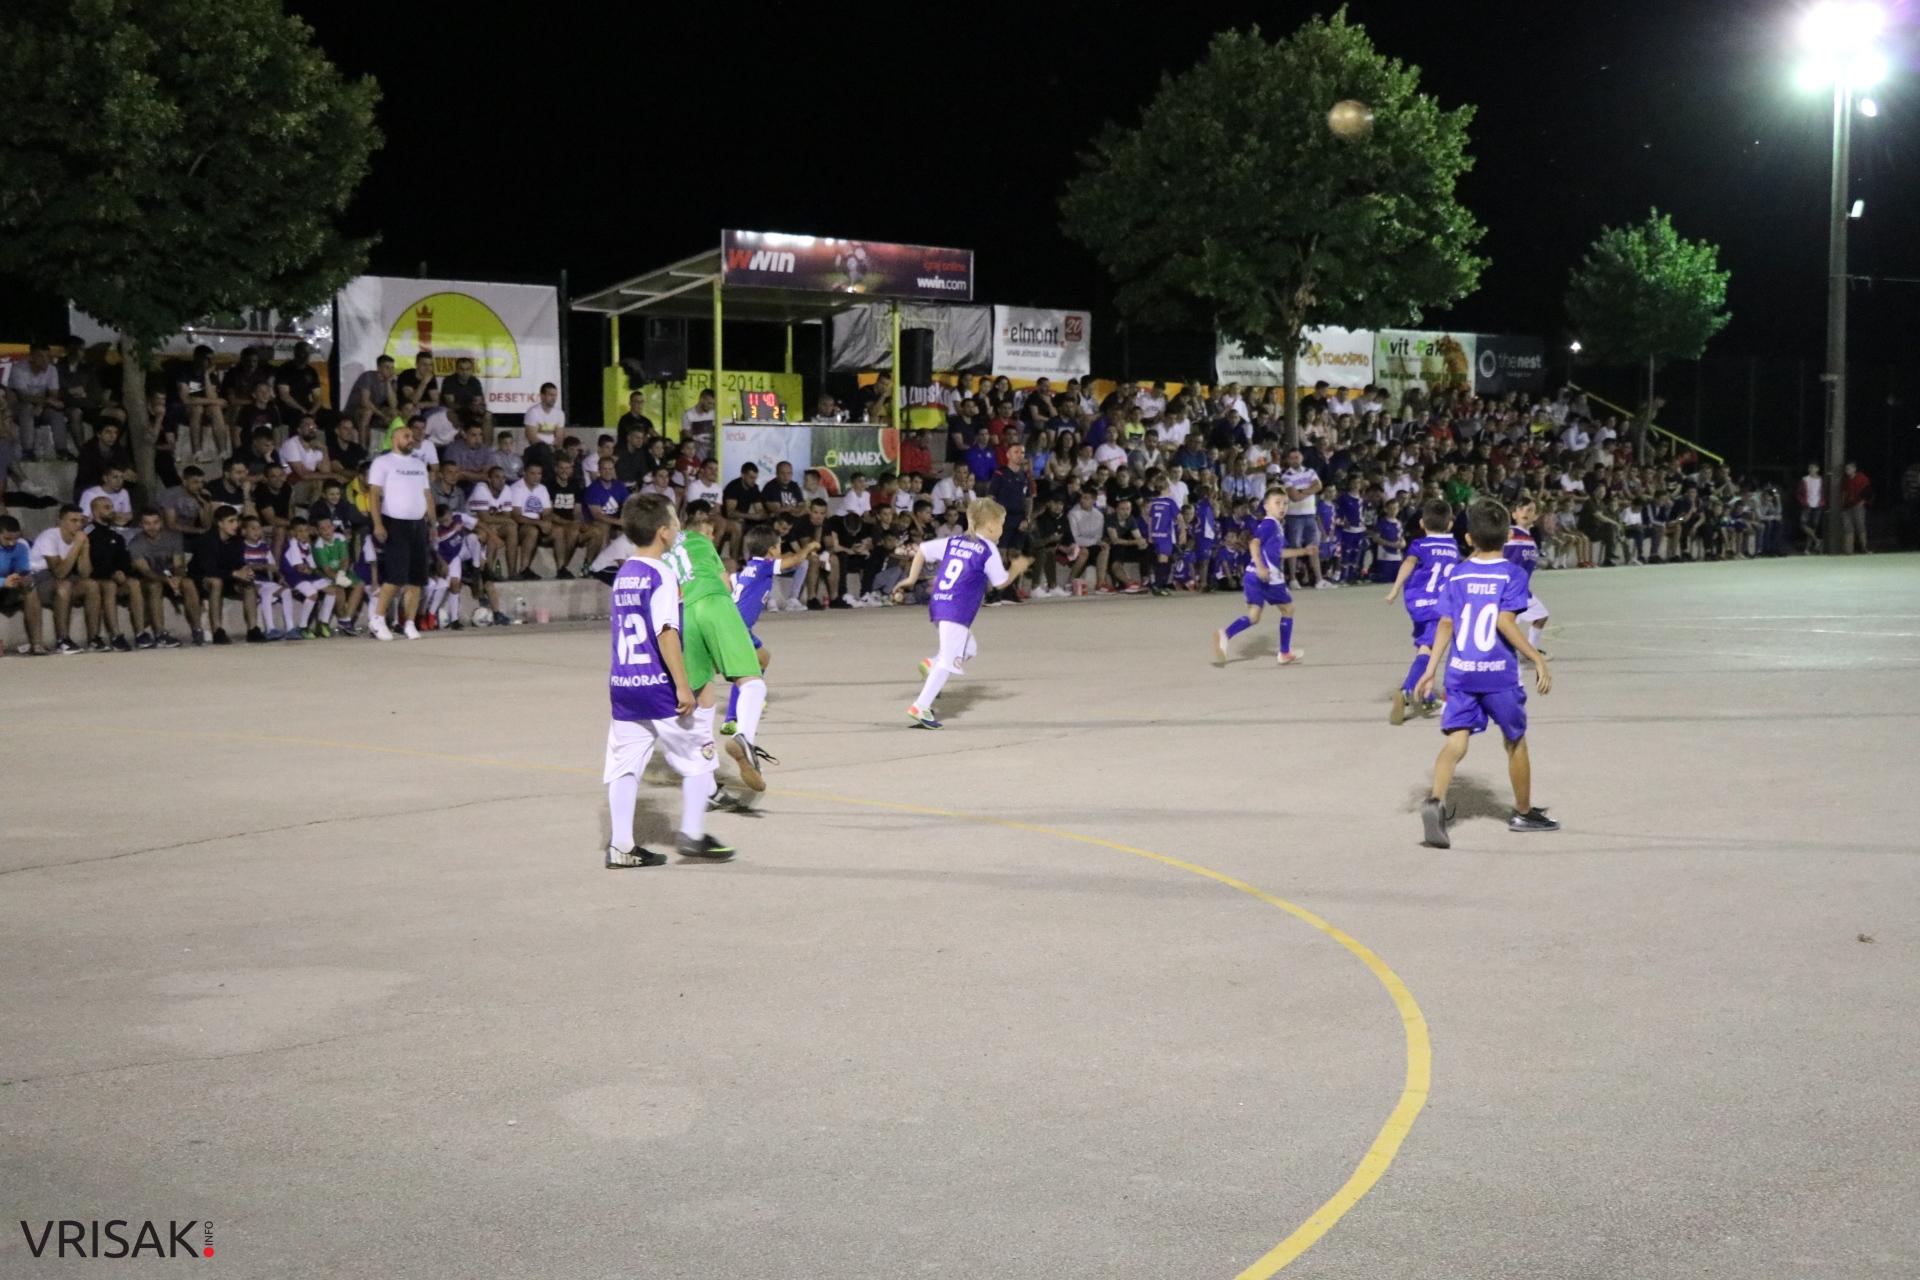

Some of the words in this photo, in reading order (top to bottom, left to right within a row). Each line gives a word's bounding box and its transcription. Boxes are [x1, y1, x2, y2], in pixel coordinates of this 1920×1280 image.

[917, 275, 967, 290] wwin.com
[1010, 322, 1059, 345] elmont
[838, 451, 882, 465] NAMEX
[938, 558, 964, 591] 9
[617, 613, 652, 666] 12
[1456, 603, 1498, 652] 10
